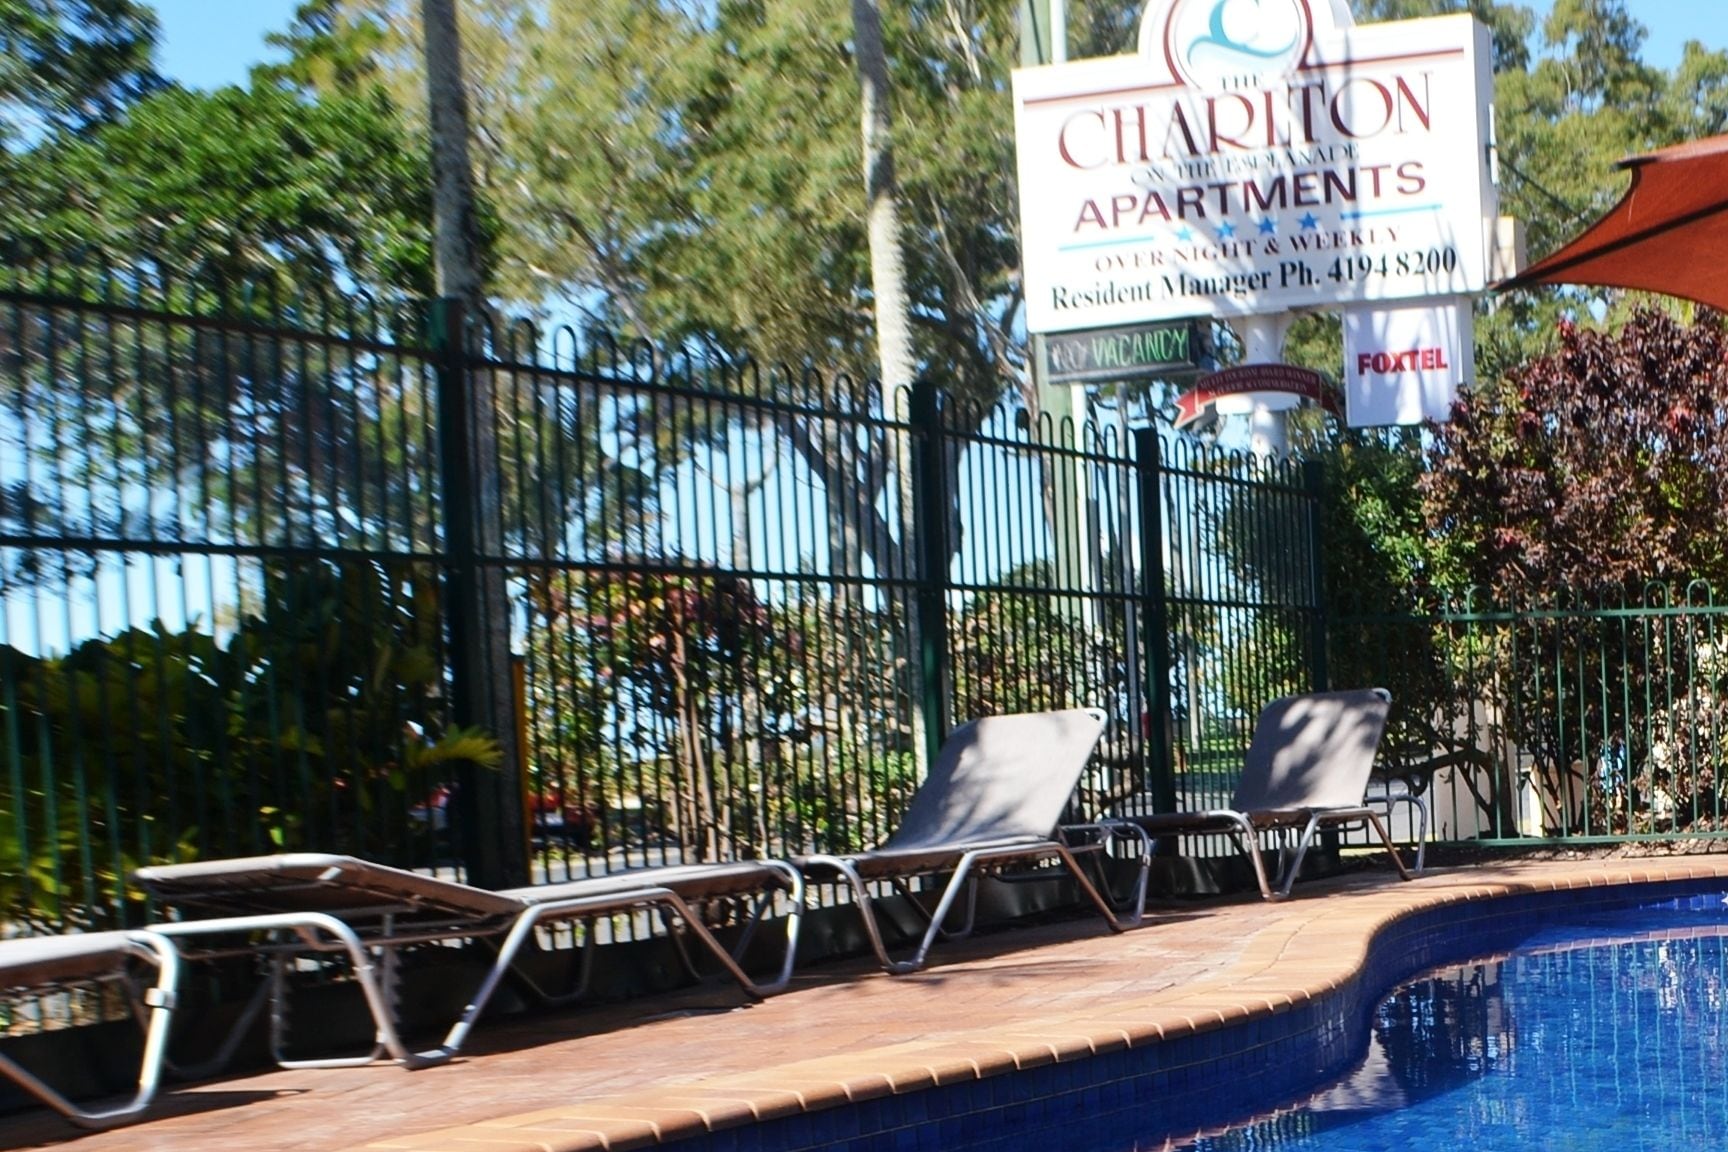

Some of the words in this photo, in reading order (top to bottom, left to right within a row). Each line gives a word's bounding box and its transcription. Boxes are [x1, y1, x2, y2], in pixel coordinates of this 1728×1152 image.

[1220, 74, 1263, 91] THE
[1058, 71, 1434, 172] CHARLTON
[1130, 168, 1165, 185] ON
[1177, 160, 1218, 180] THE
[1226, 143, 1360, 175] ESPLANADE
[1073, 161, 1426, 232] APARTMENTS
[1264, 235, 1281, 256] &
[1288, 226, 1400, 253] WEEKLY
[1052, 273, 1152, 312] Resident
[1160, 265, 1272, 301] Manager
[1278, 259, 1320, 288] Ph.
[1327, 252, 1388, 282] 4194
[1396, 246, 1457, 277] 8200
[1091, 327, 1189, 368] VACANCY
[1357, 347, 1448, 376] FOXTEL
